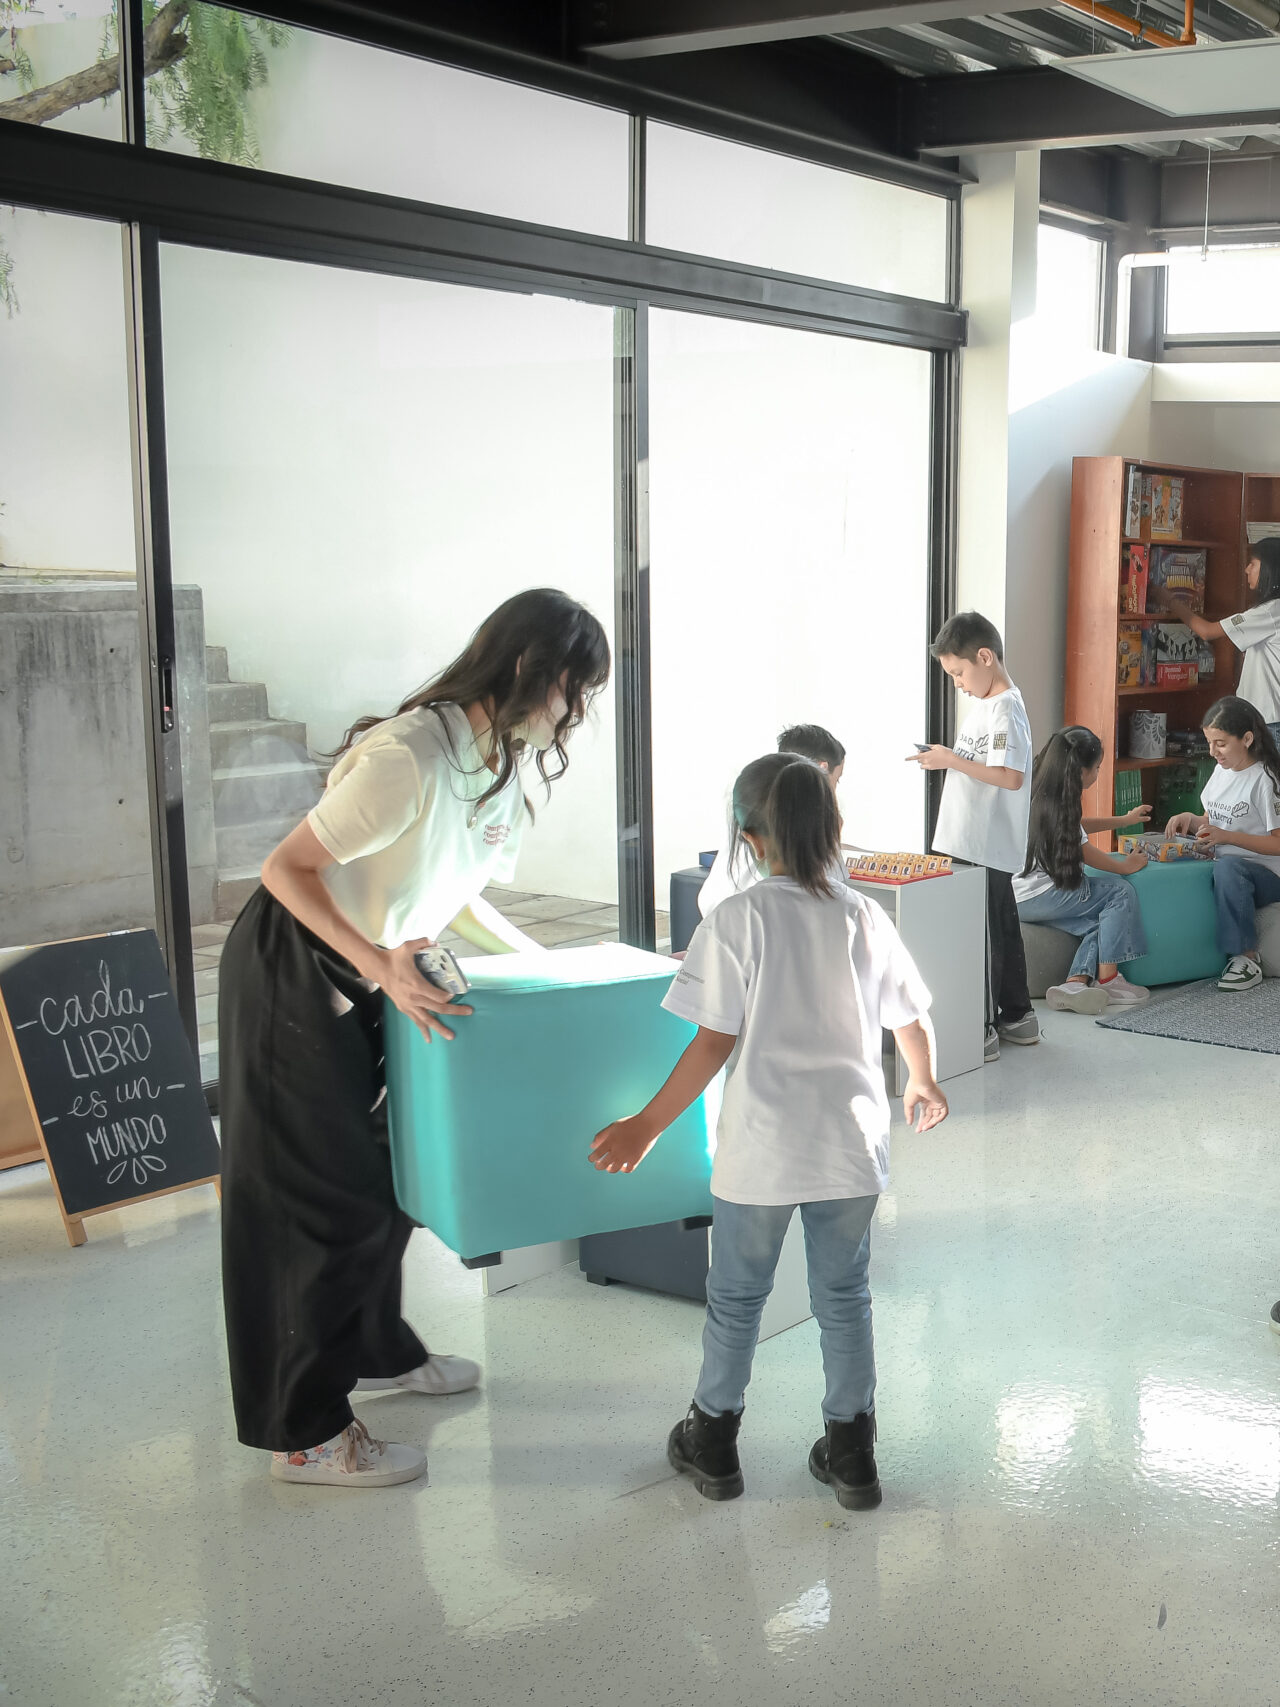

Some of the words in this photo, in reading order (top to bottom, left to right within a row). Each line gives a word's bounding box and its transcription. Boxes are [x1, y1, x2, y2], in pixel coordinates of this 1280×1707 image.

[40, 960, 145, 1035] cada
[62, 1023, 152, 1079] LIBRO
[67, 1090, 108, 1118] es
[116, 1076, 161, 1103] un
[86, 1113, 167, 1166] MUNDO
